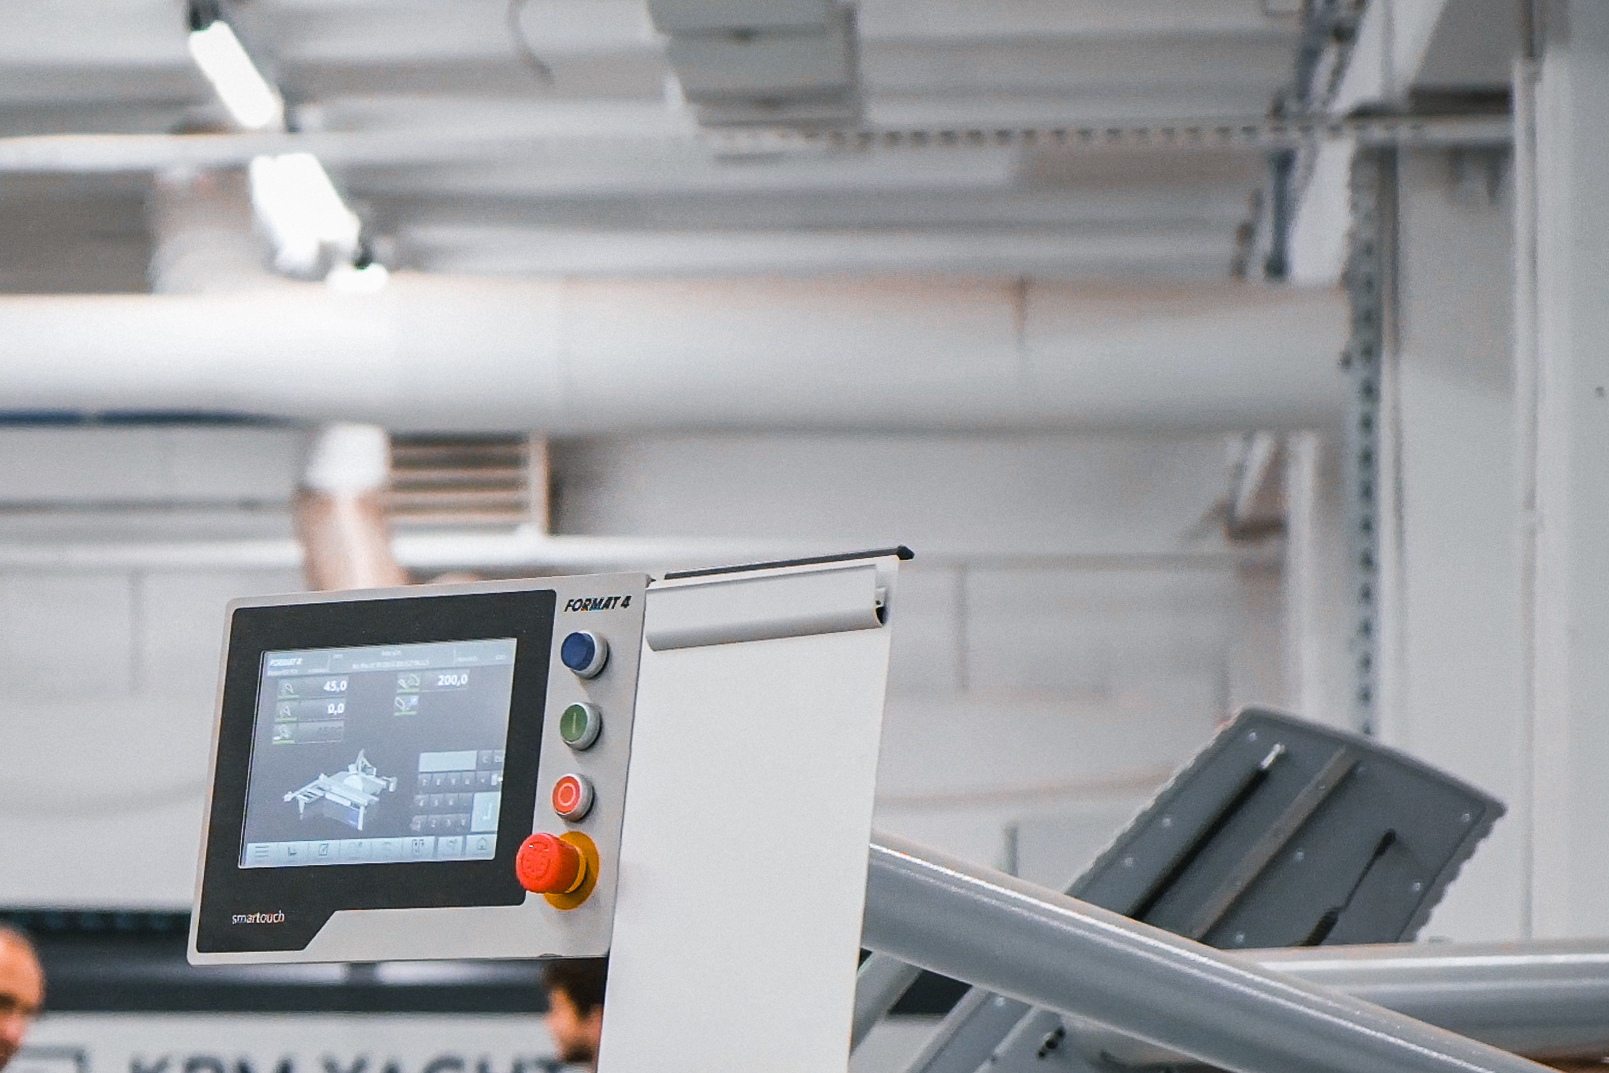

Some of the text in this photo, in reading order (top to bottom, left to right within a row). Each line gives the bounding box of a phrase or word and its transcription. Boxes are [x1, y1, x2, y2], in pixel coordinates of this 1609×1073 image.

[564, 595, 632, 612] FORMAT 4
[323, 680, 347, 692] 45,0
[437, 674, 468, 687] 200,0
[327, 703, 344, 715] 0,0
[232, 910, 285, 924] smartouch
